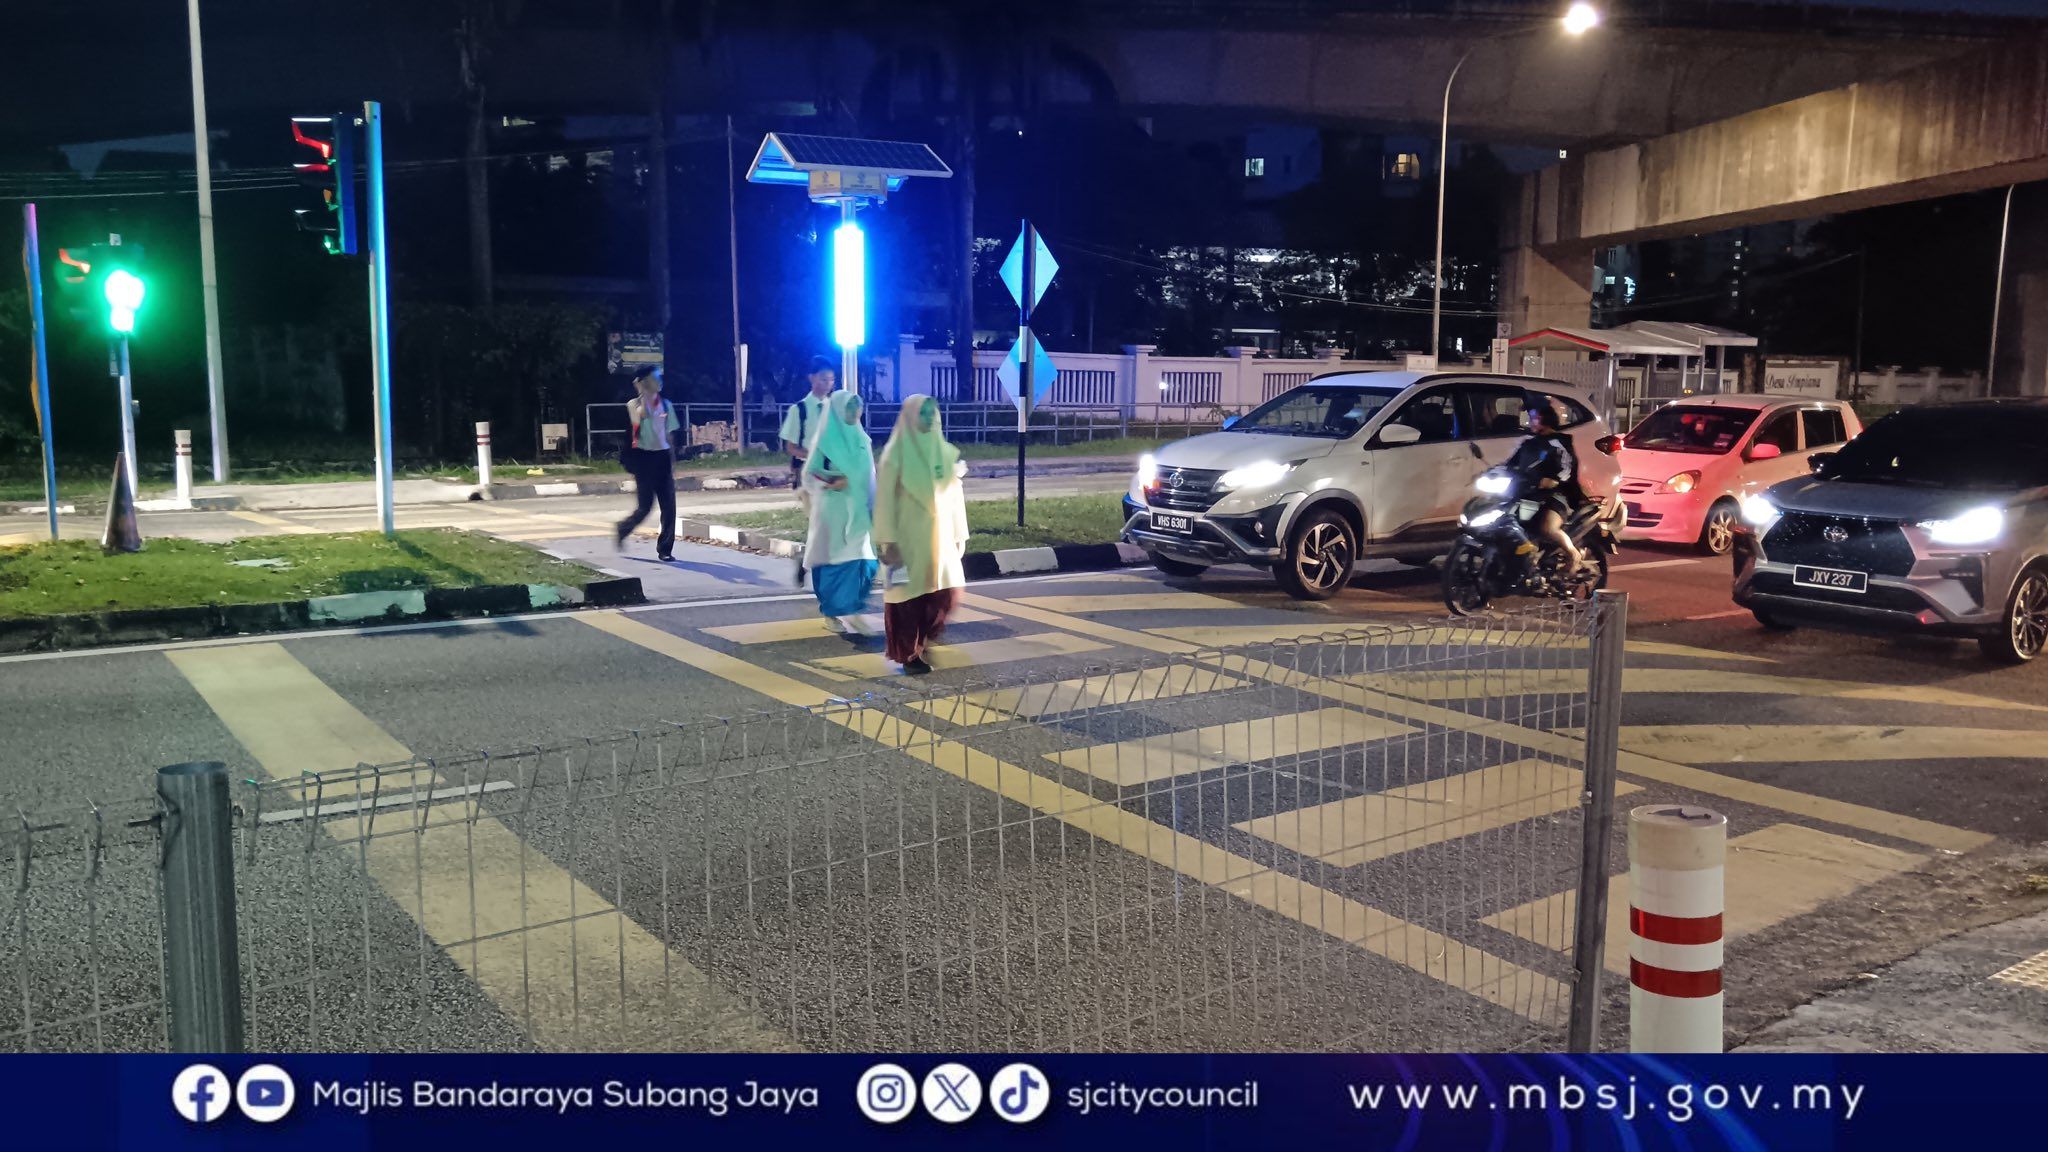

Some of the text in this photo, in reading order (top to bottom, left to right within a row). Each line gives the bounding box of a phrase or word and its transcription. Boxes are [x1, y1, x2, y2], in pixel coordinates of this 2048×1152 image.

[1157, 514, 1187, 529] VHS 6301
[1809, 570, 1853, 586] JXY 237
